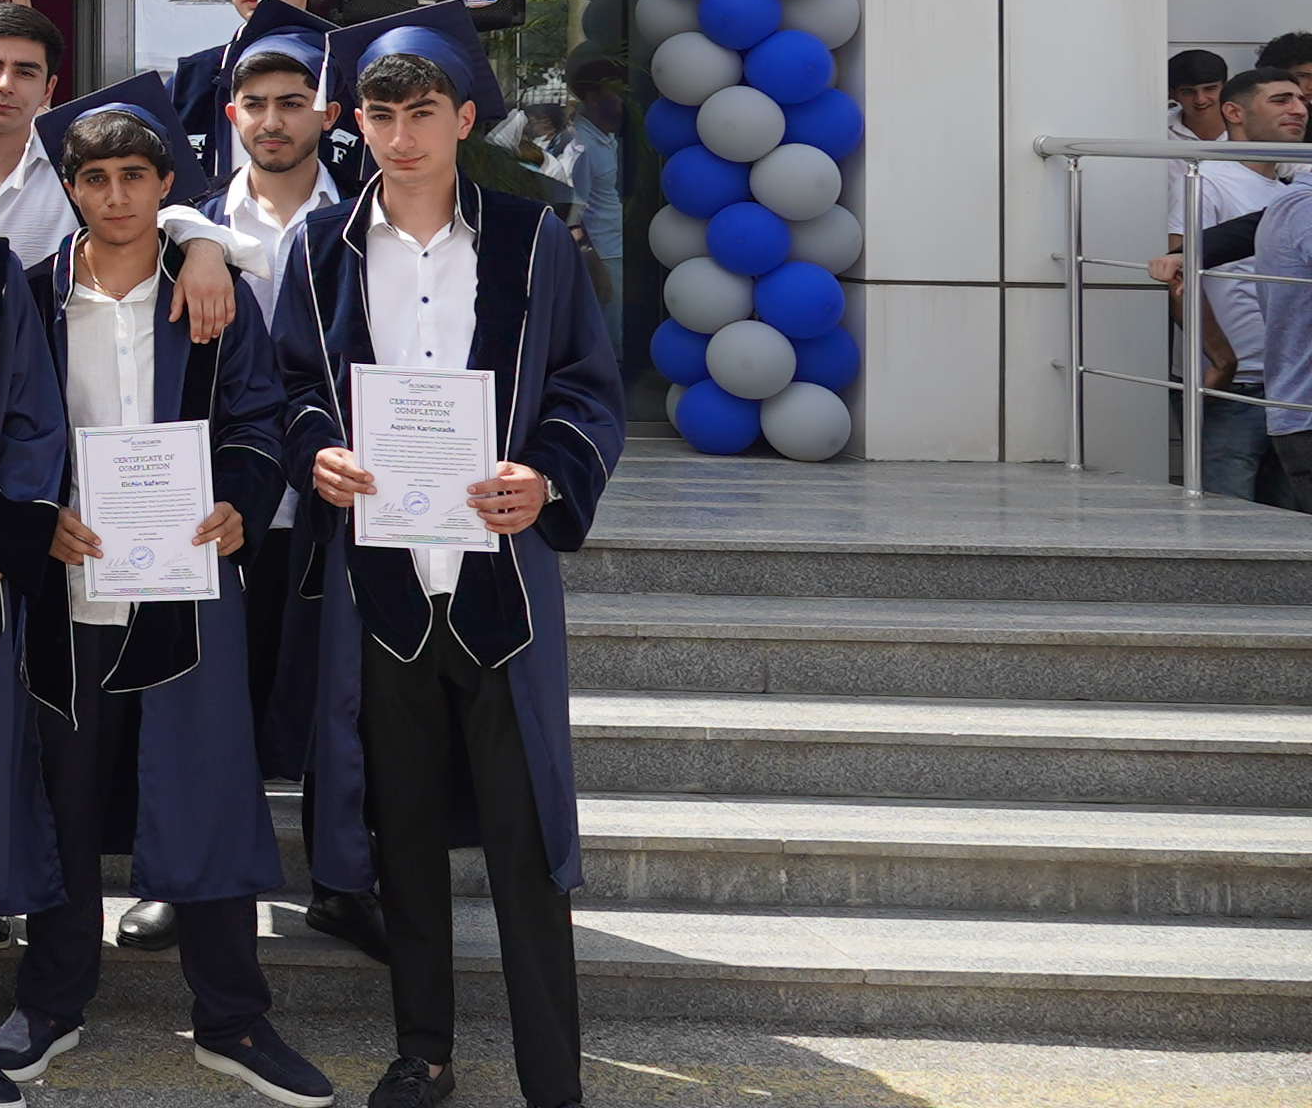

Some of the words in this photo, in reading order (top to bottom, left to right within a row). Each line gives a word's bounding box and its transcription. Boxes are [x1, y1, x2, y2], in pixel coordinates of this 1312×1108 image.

[389, 397, 442, 407] CERTIFICATE
[394, 407, 450, 416] COMPLETION
[112, 455, 163, 463] CERTIFICATE
[164, 453, 175, 461] OF
[118, 463, 170, 472] COMPLETION
